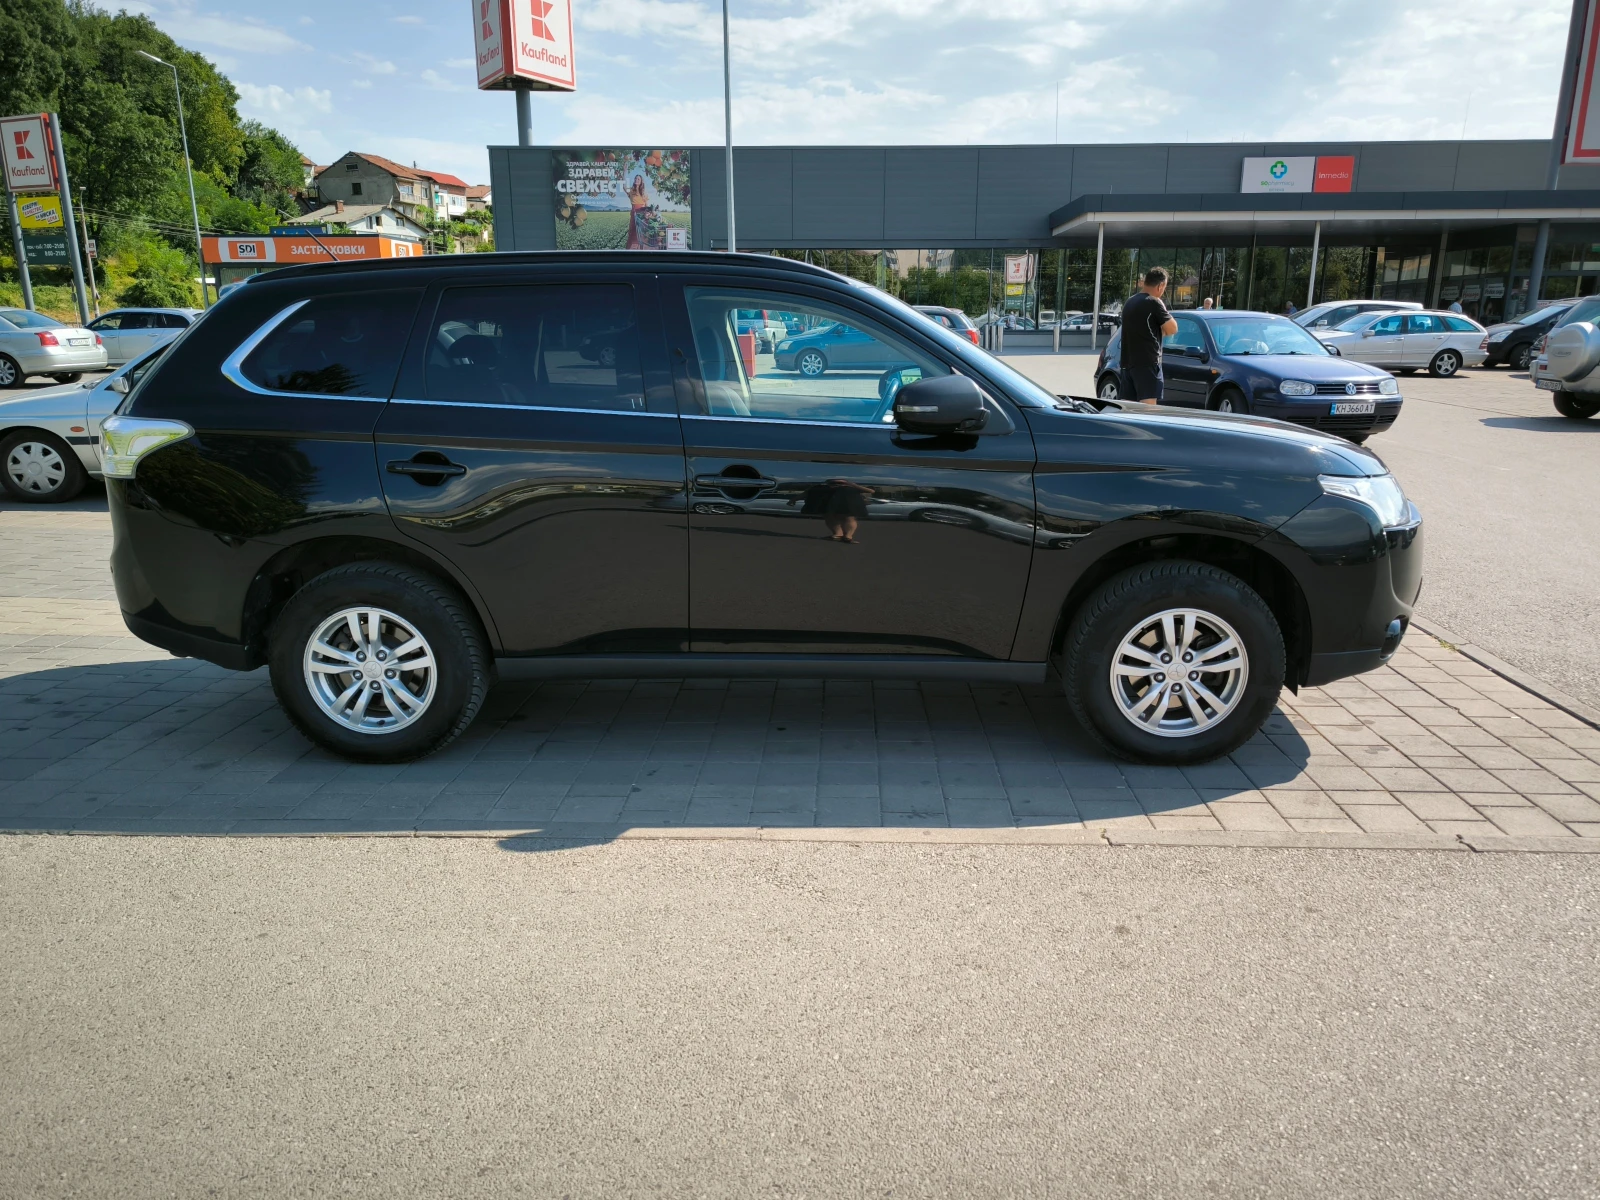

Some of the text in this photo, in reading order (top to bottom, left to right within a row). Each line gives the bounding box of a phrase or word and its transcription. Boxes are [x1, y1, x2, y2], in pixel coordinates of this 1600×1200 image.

[479, 42, 500, 66] Kaufland
[521, 42, 567, 67] Kaufland
[11, 165, 45, 177] Kaufland
[568, 166, 618, 179] ЗДРАВЕЙ,
[557, 179, 630, 193] СВЕЖЕСТ!
[238, 244, 256, 254] SDI
[1336, 404, 1374, 413] KH 3660 AT
